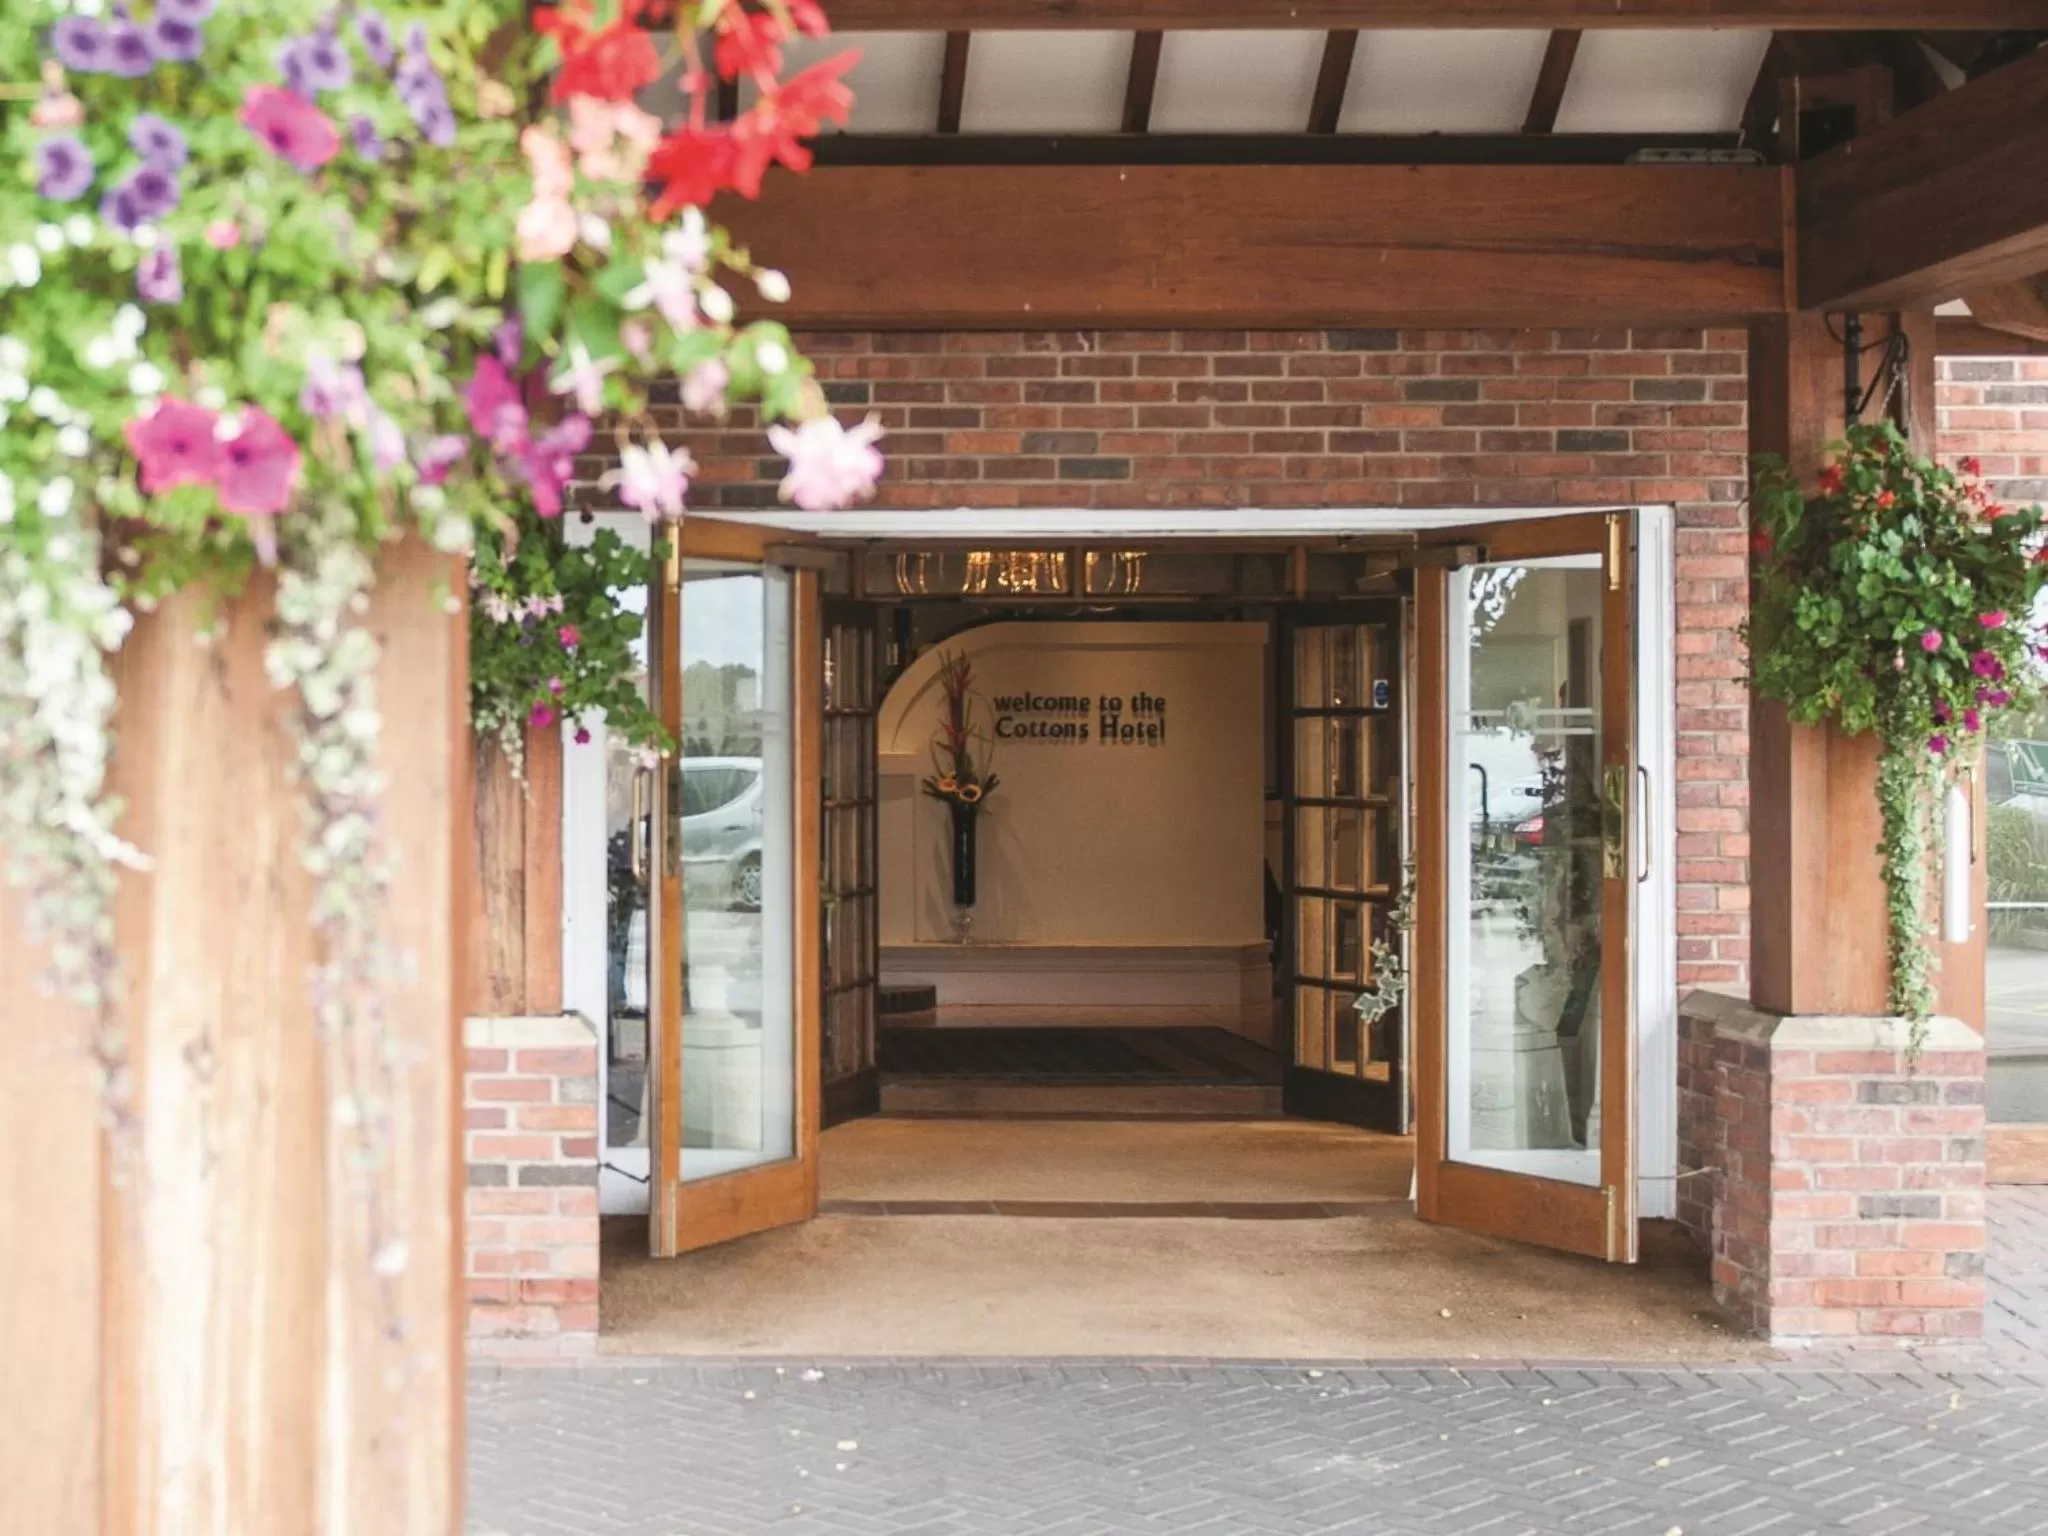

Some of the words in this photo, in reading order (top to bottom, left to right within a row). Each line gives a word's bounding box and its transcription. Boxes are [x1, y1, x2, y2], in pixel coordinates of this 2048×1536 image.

[995, 691, 1091, 712] welcome
[1099, 694, 1124, 712] to
[1130, 691, 1166, 712] the
[995, 715, 1089, 738] Cottons
[1099, 715, 1166, 738] Hotel
